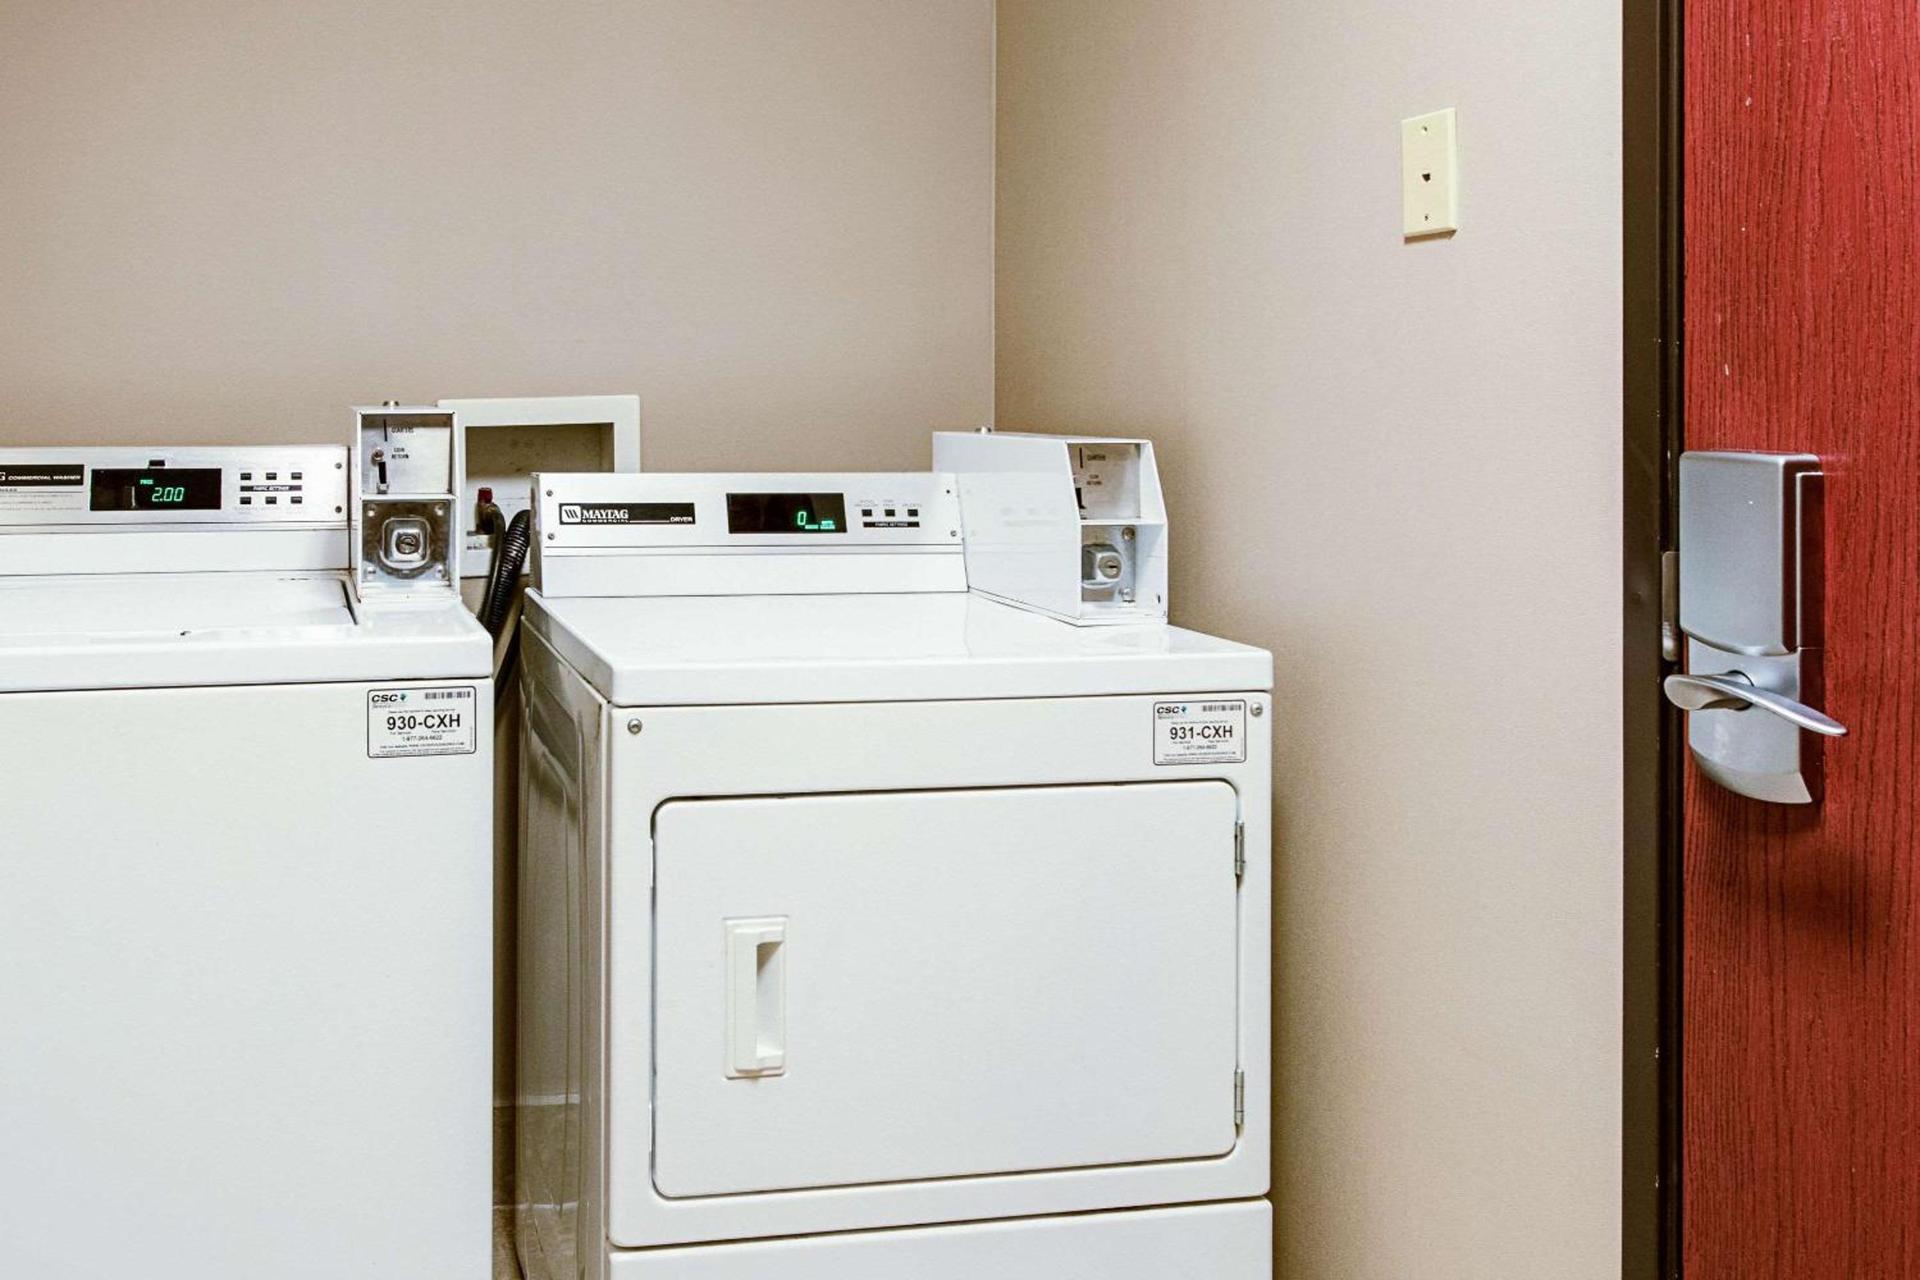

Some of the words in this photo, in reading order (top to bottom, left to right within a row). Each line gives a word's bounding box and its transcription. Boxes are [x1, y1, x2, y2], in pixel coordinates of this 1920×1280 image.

[152, 487, 185, 502] 2.00
[582, 509, 629, 519] MAYTAG
[797, 511, 807, 526] 0
[371, 694, 398, 703] CSC
[1156, 706, 1180, 714] CSC
[387, 713, 461, 730] 930-CXH
[1170, 725, 1233, 740] 931-CXH
